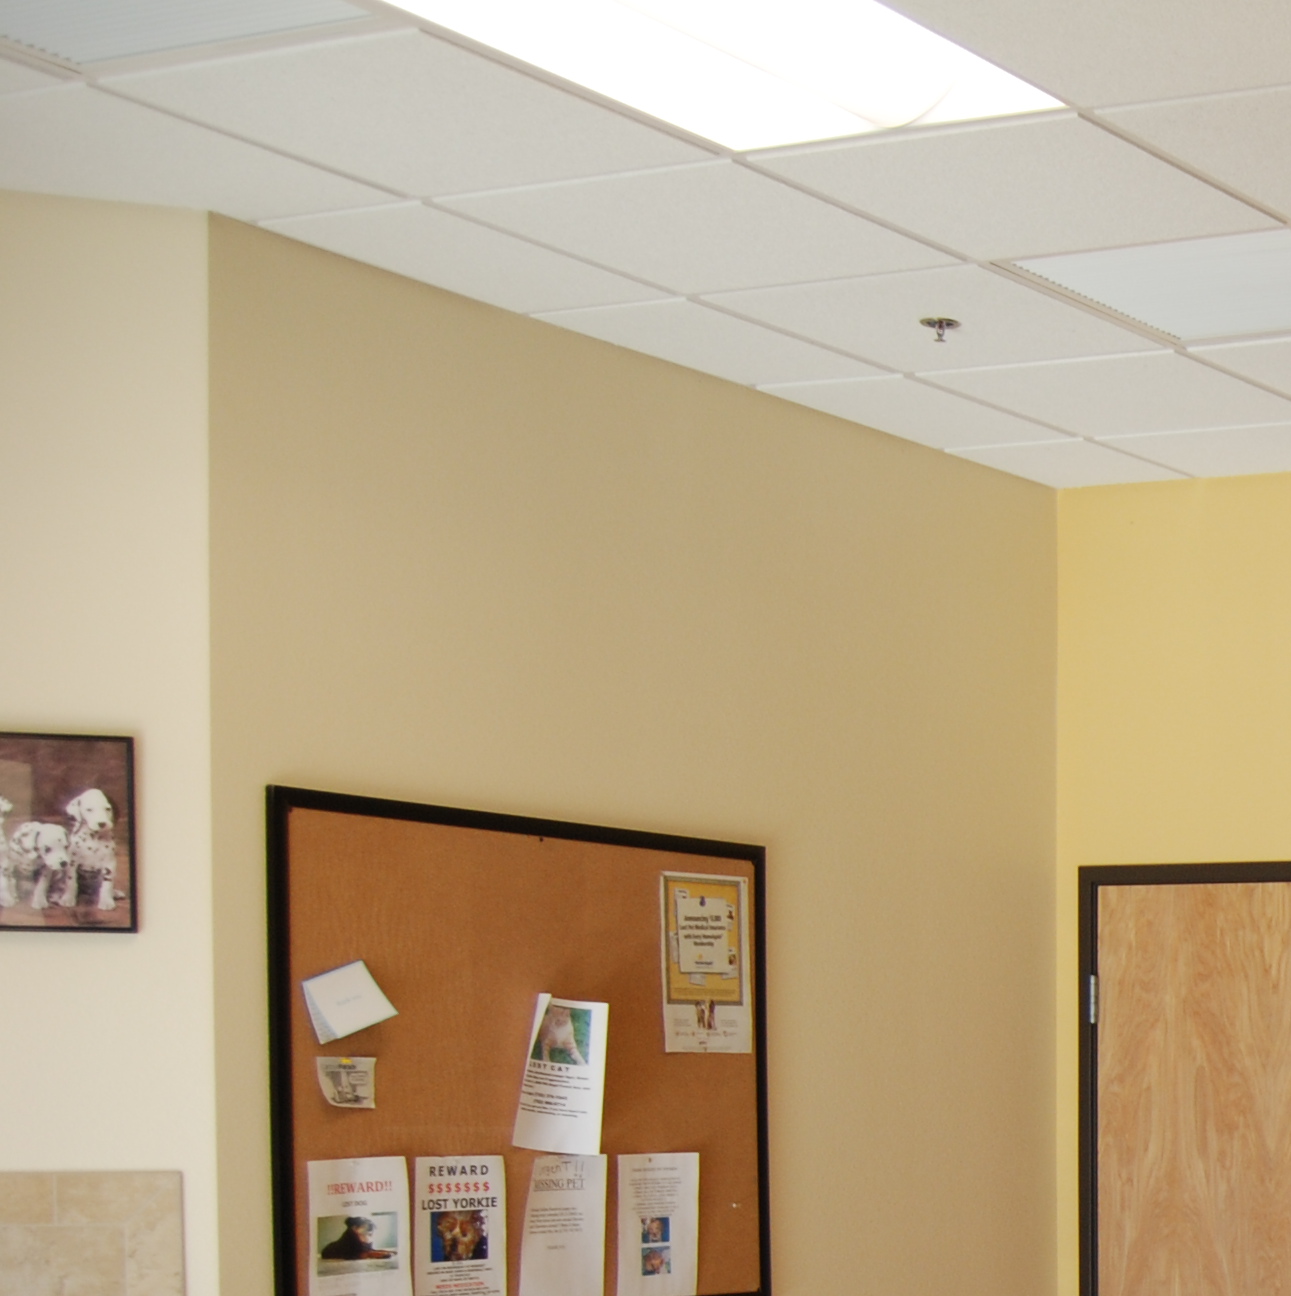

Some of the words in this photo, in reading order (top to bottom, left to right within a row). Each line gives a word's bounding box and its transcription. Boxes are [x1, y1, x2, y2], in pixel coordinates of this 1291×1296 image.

[428, 1164, 490, 1178] REWARD
[327, 1180, 393, 1196] !!REWARD!!
[421, 1198, 450, 1211] LOST
[451, 1196, 498, 1210] YORKIE
